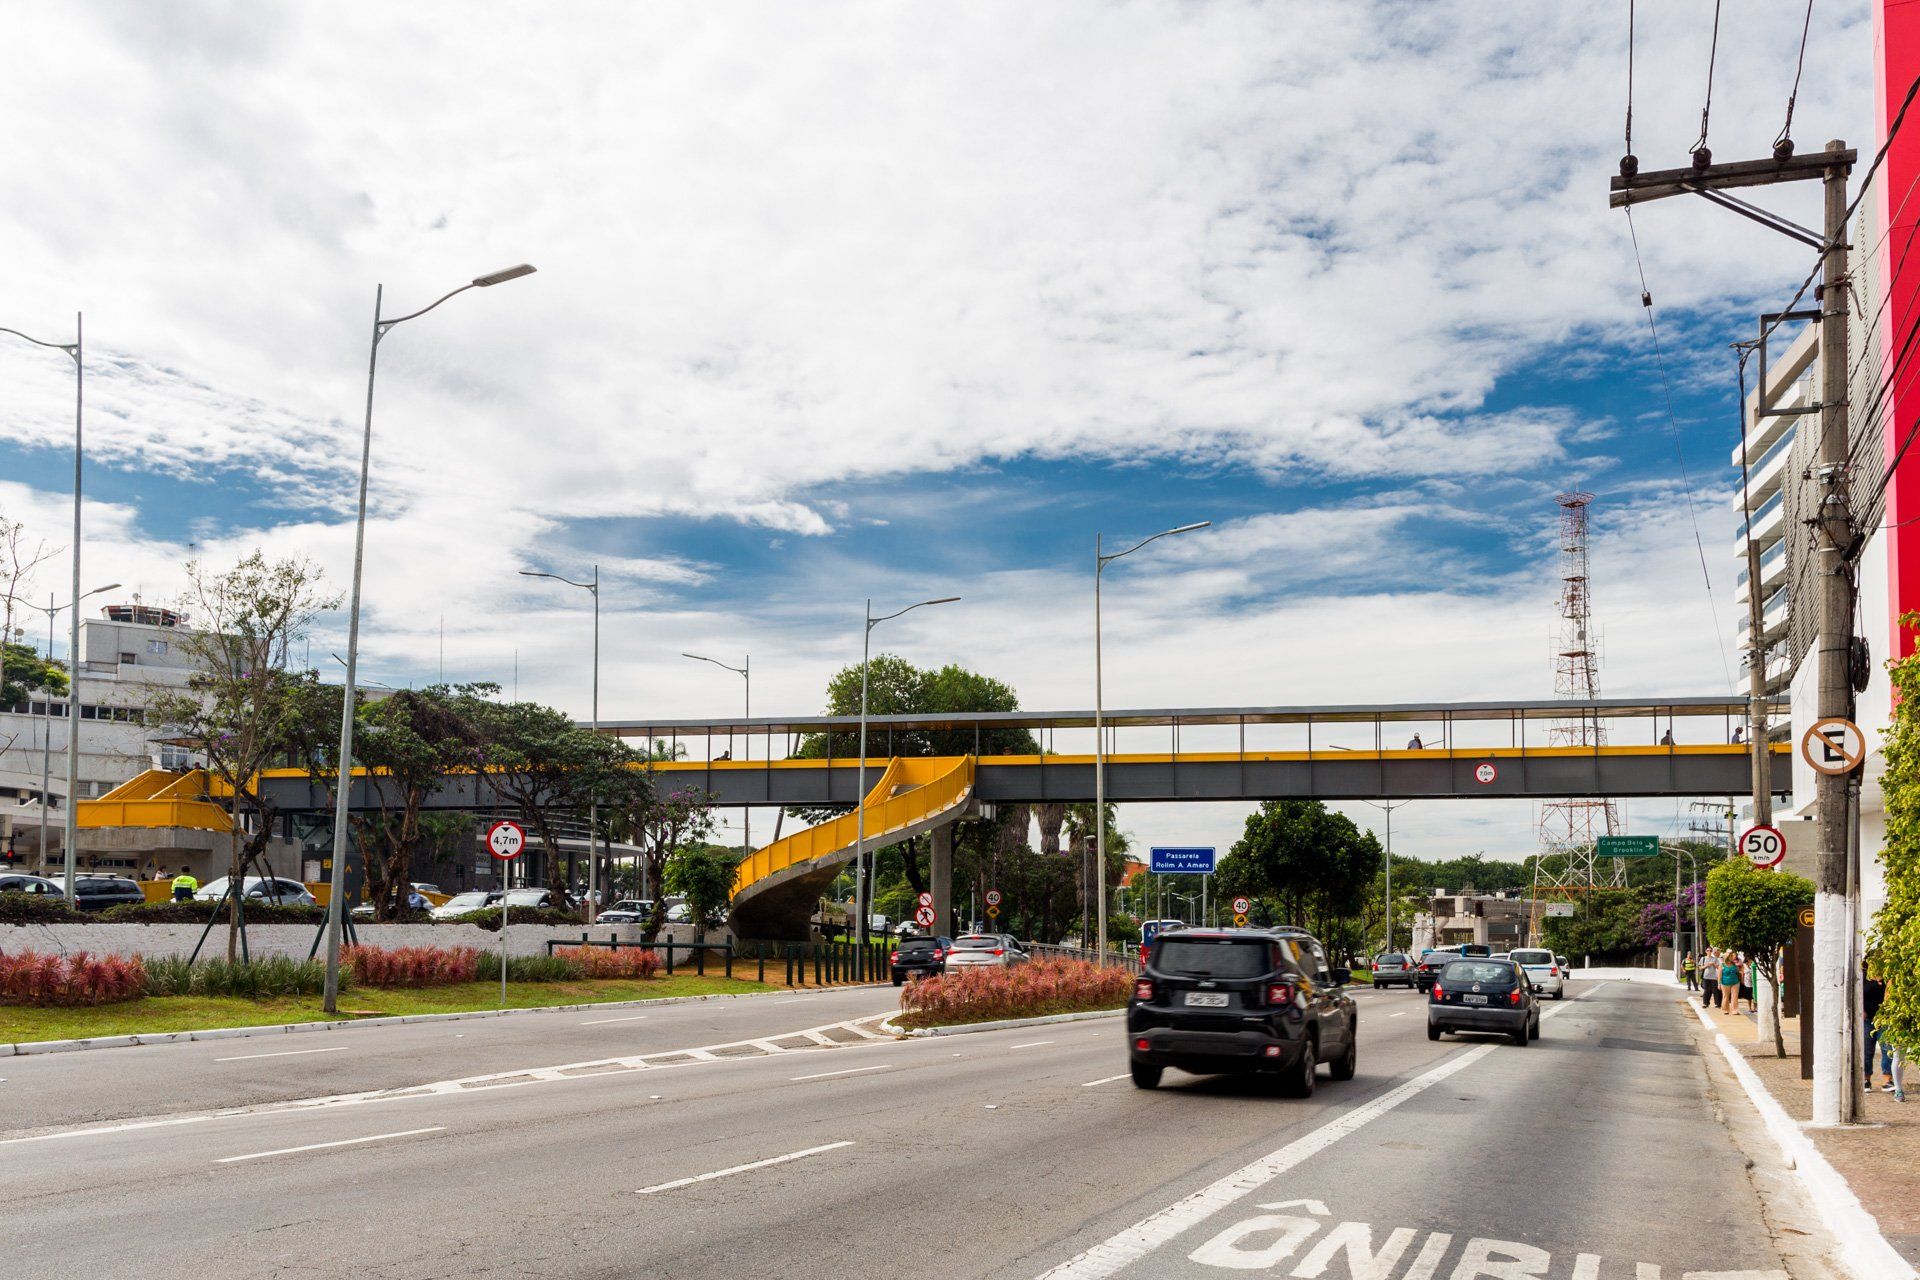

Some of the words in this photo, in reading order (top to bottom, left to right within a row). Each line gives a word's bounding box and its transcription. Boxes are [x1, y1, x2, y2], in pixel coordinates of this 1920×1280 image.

[493, 836, 518, 847] 4,7m
[1748, 835, 1778, 853] 50
[1236, 901, 1246, 909] 40
